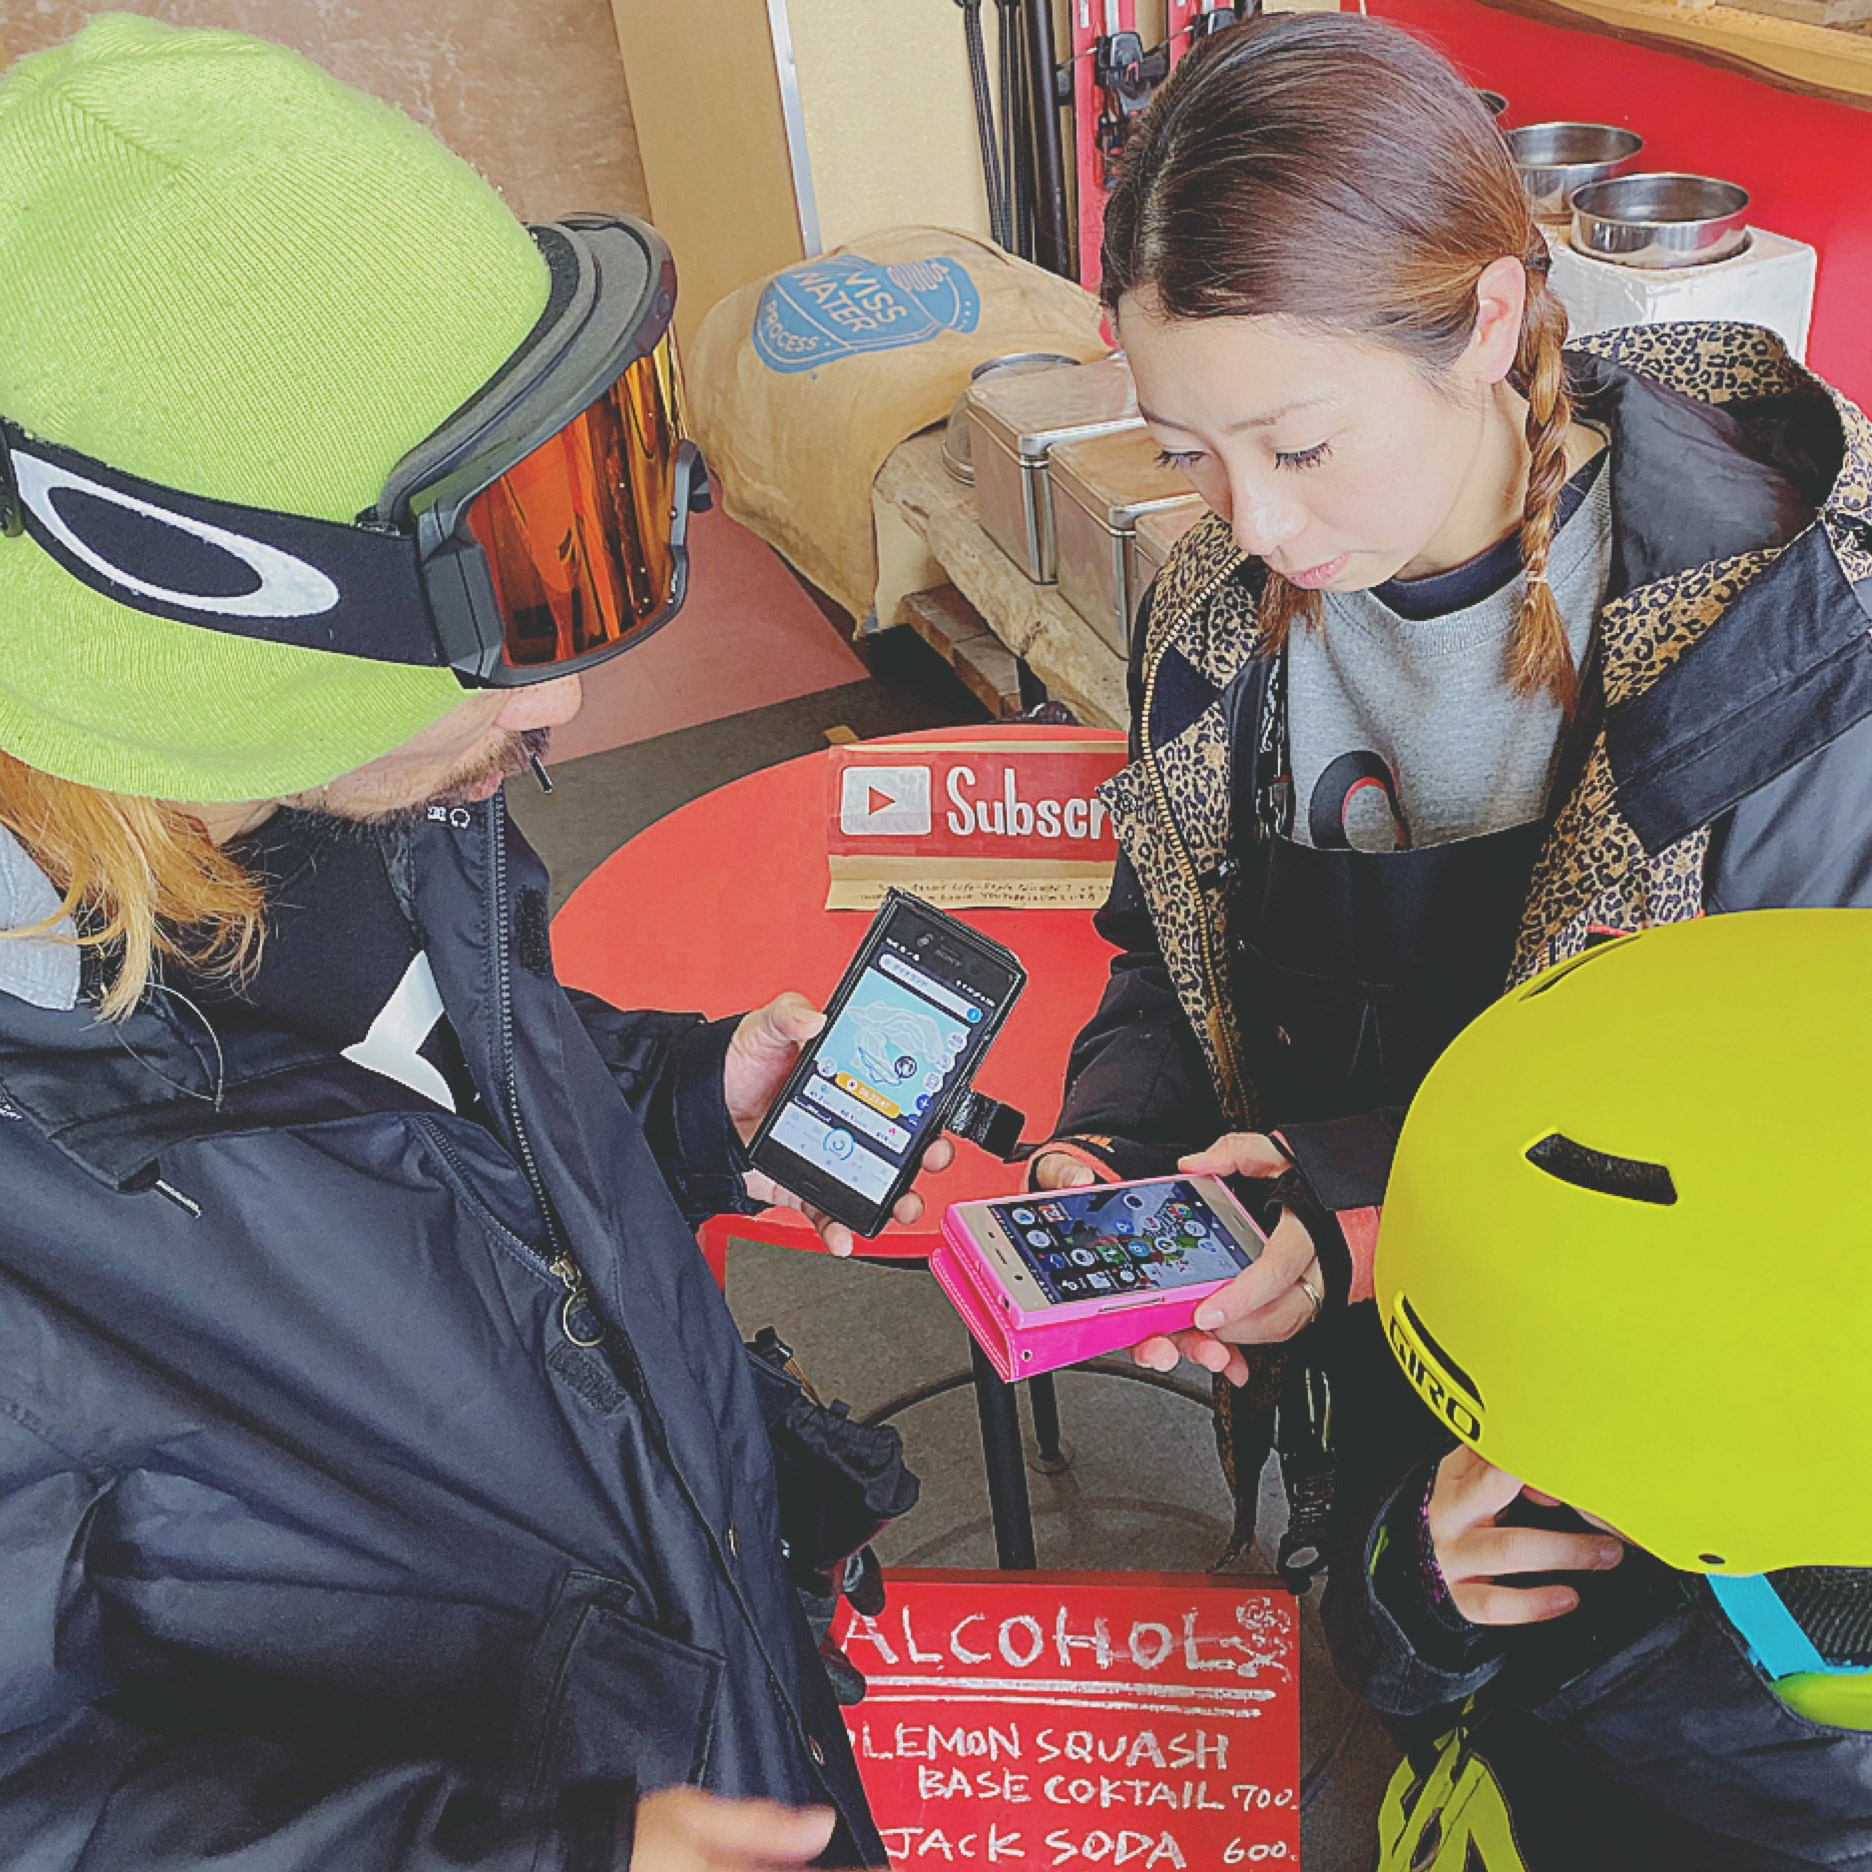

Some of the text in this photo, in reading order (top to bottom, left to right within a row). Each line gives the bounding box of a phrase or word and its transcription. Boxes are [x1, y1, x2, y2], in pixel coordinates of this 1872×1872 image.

[845, 270, 907, 322] VISS
[767, 299, 820, 352] PROCESS
[946, 766, 1123, 840] Subscr
[1390, 1315, 1481, 1443] GIRO
[840, 1605, 1236, 1670] ALCOHOL
[862, 1722, 1229, 1770] LEMON SQUASH
[918, 1764, 1032, 1804] BASE
[1044, 1775, 1226, 1810] COKTAIL
[1044, 1828, 1187, 1869] SODA
